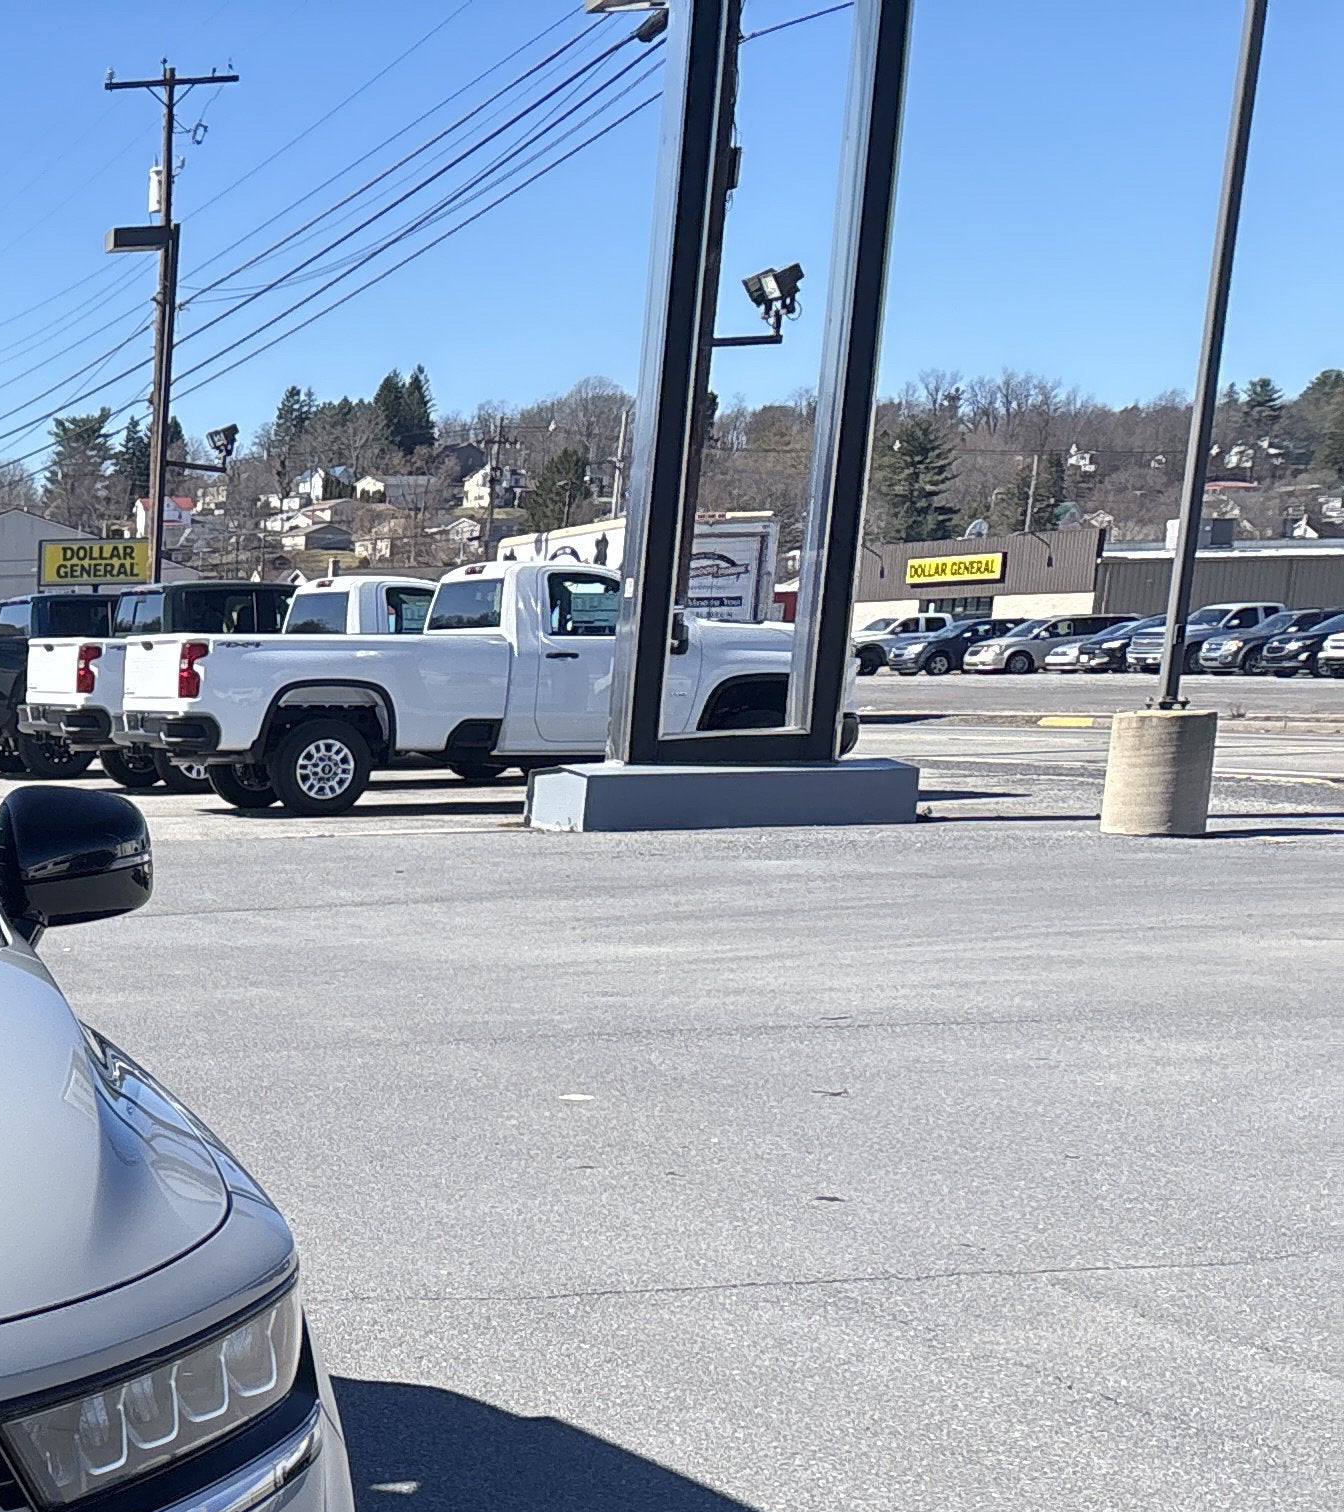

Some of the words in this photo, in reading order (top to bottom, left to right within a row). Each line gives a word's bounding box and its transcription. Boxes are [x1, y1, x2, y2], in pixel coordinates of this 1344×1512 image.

[62, 545, 135, 562] DOLLAR
[56, 562, 139, 579] GENERAL
[909, 563, 947, 579] DOLLAR
[950, 559, 995, 576] GENERAL
